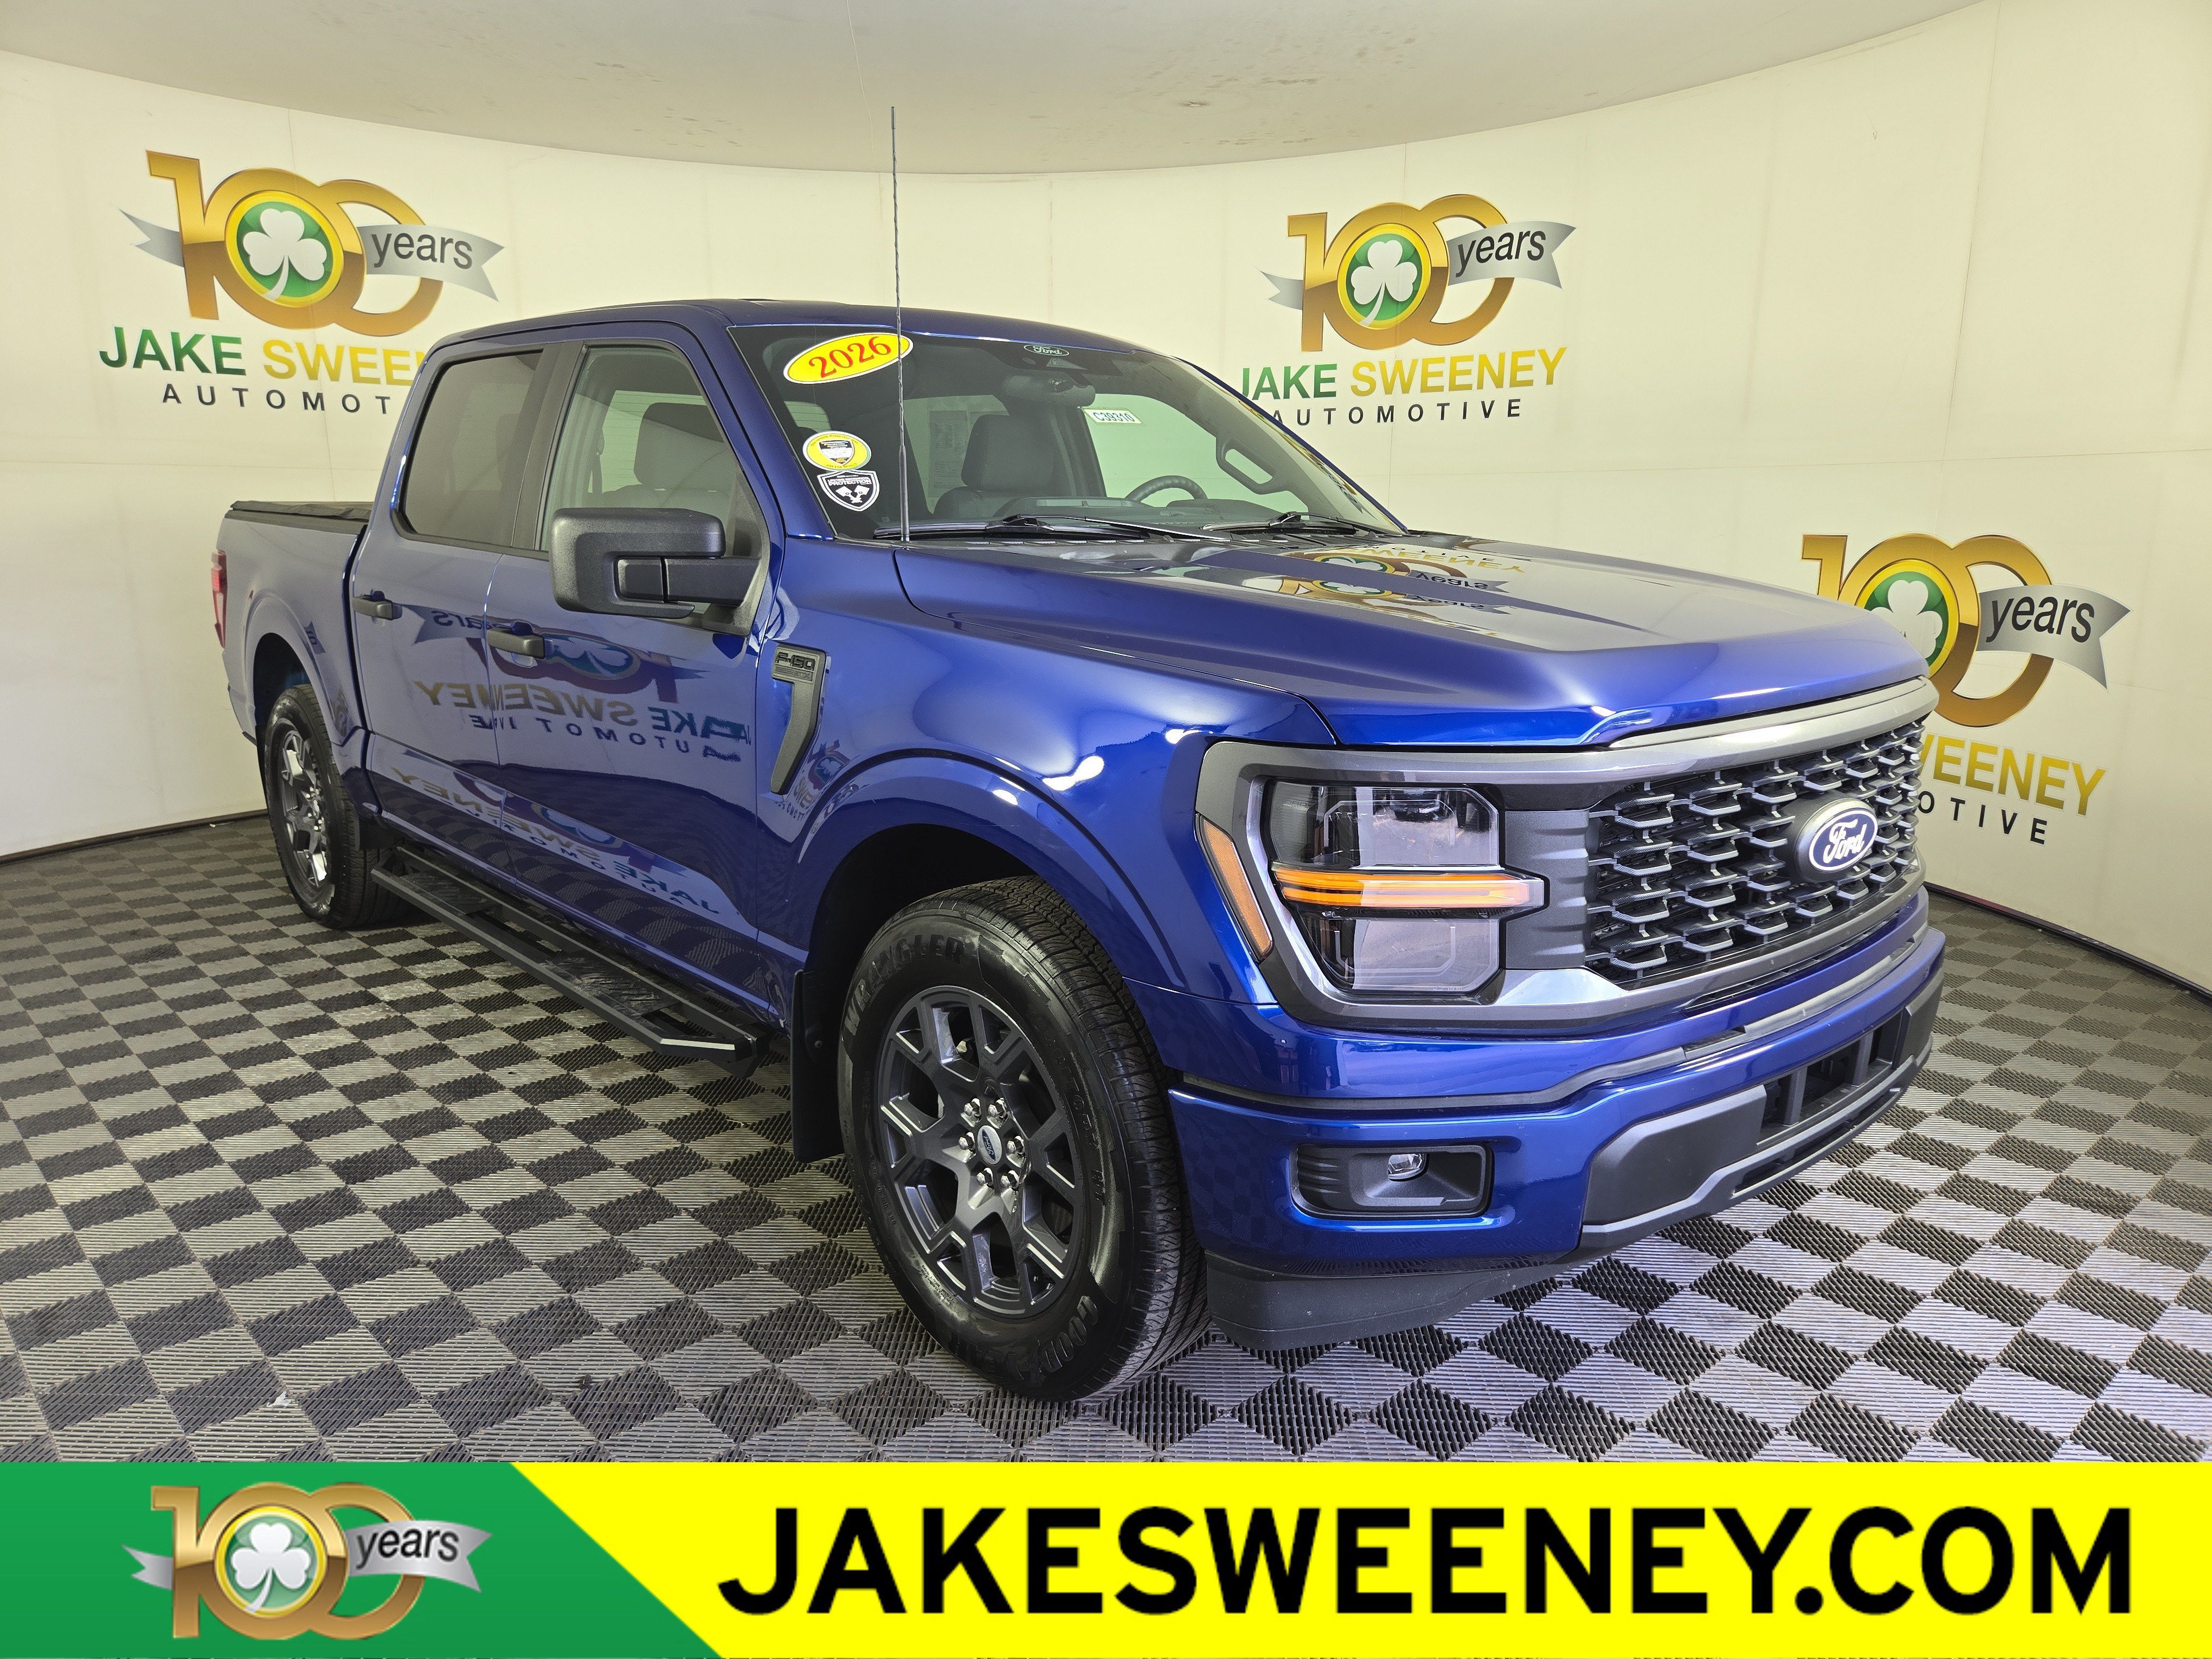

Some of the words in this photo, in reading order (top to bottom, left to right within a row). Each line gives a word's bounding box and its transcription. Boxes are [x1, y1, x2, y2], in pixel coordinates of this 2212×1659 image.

[371, 232, 473, 270] years
[1456, 229, 1546, 278] years
[99, 326, 247, 377] JAKE
[808, 337, 891, 378] 2026
[1033, 345, 1063, 355] Ford
[1351, 347, 1567, 397] SWEENEY
[1093, 411, 1135, 422] C39310
[1985, 596, 2094, 643] years
[775, 652, 815, 671] F-150
[1823, 818, 1866, 865] Ford
[845, 934, 965, 1036] WRANGLER
